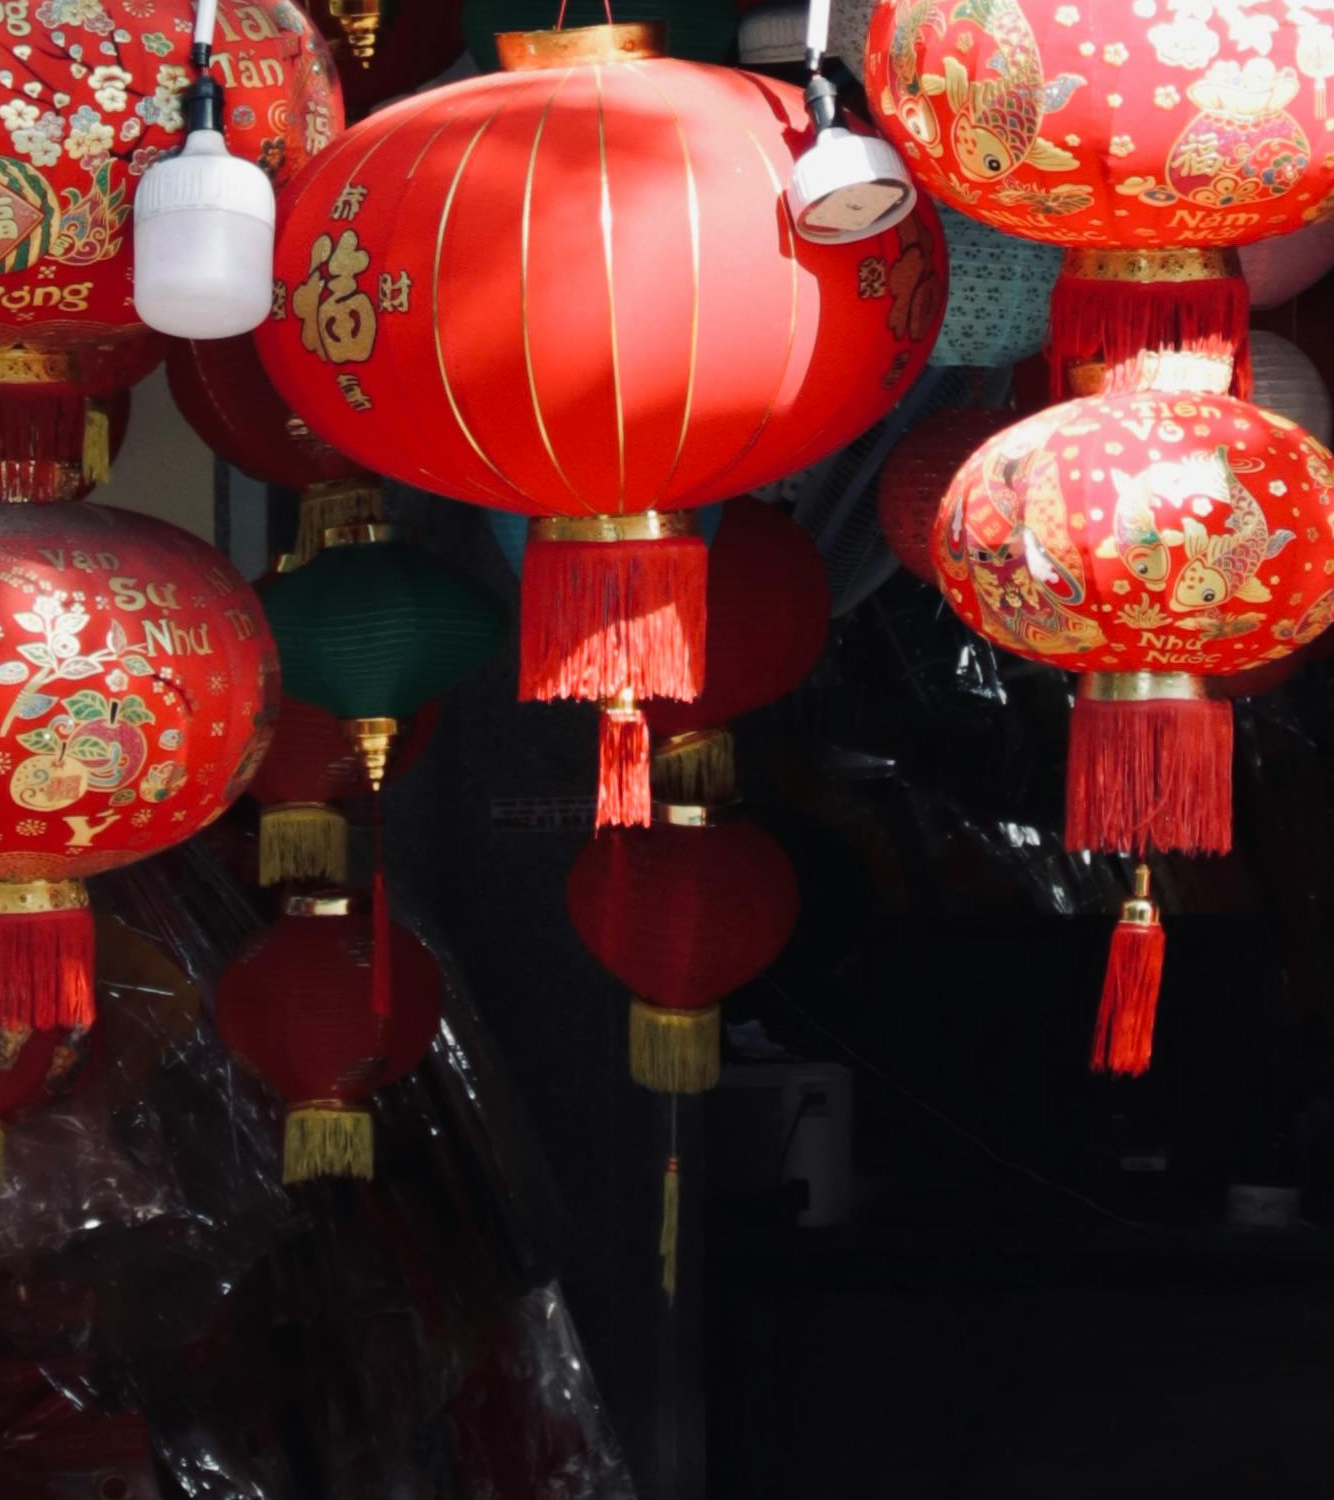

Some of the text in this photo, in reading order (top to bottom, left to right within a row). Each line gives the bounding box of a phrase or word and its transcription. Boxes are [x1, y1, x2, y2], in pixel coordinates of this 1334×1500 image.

[208, 50, 285, 89] Tấn
[1170, 131, 1223, 177] 福
[38, 545, 122, 573] Vạn
[107, 576, 183, 617] Sự
[144, 617, 214, 659] Như
